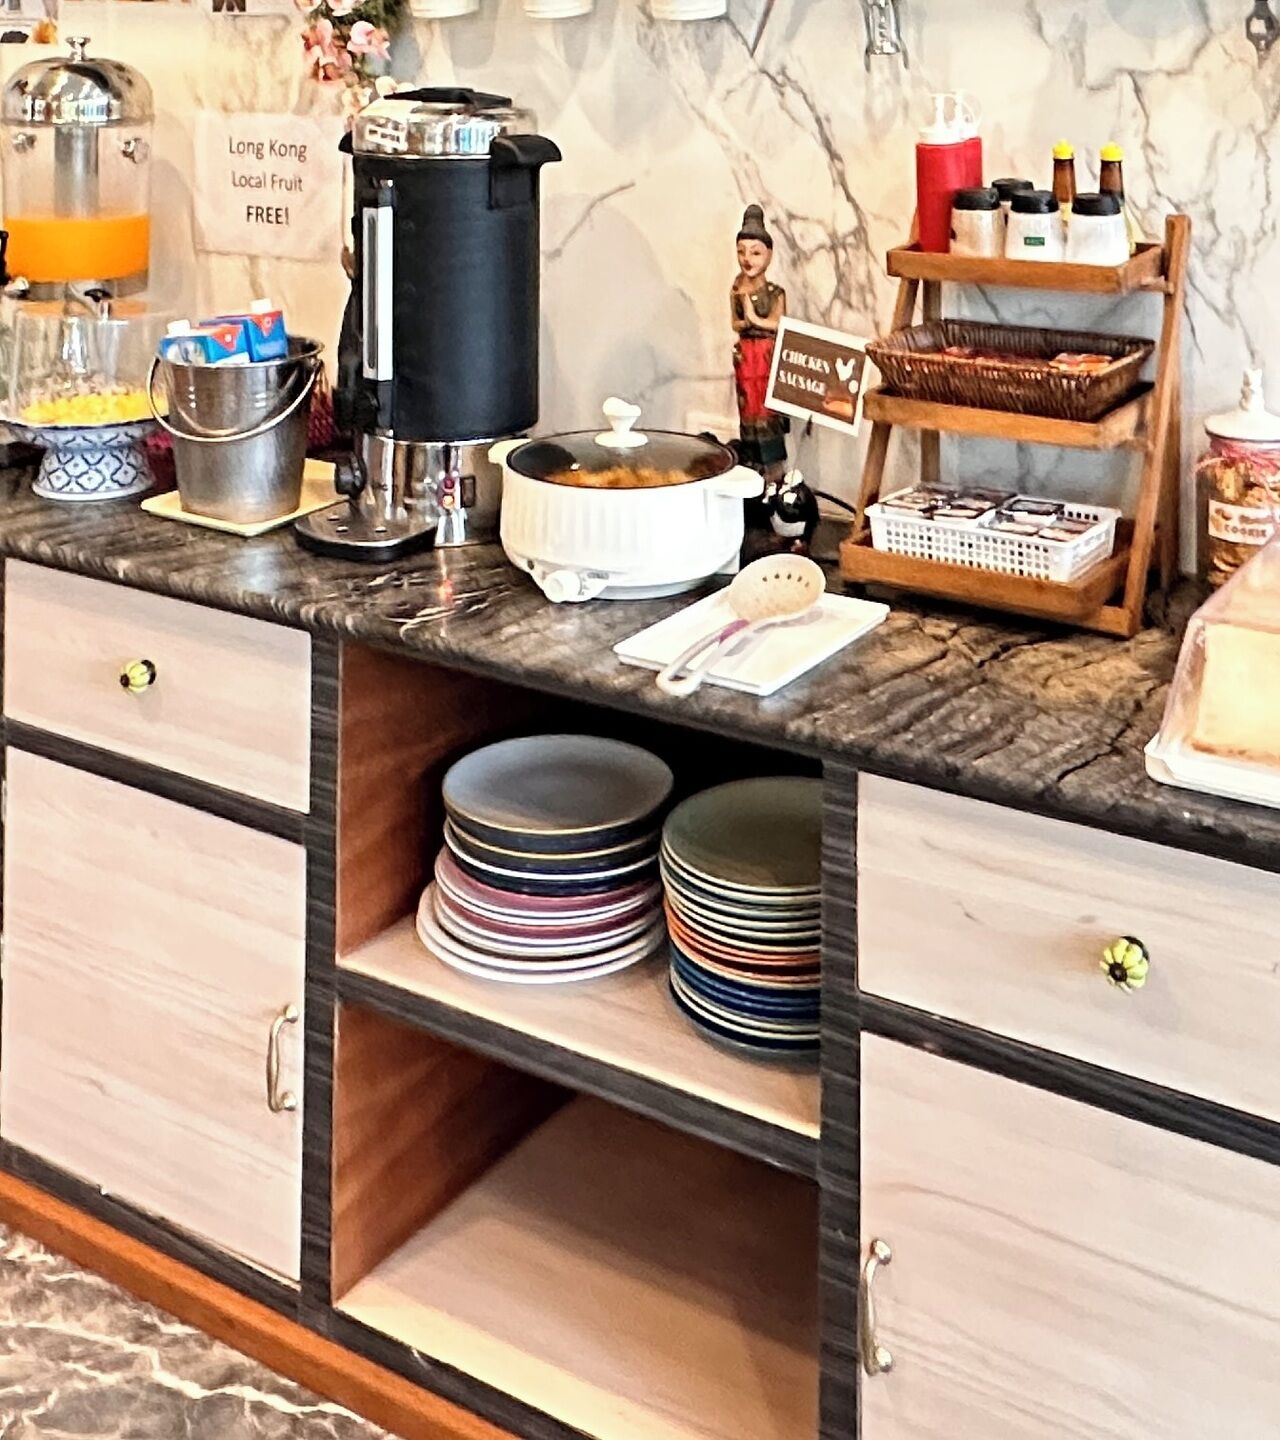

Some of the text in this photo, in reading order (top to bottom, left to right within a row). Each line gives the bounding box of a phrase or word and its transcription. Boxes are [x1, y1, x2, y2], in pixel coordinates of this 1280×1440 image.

[228, 136, 307, 163] Long Kong
[231, 170, 303, 192] Local Fruit
[246, 205, 289, 225] FREE!
[782, 349, 830, 374] CHICKEN
[778, 370, 826, 396] SAUSAGE
